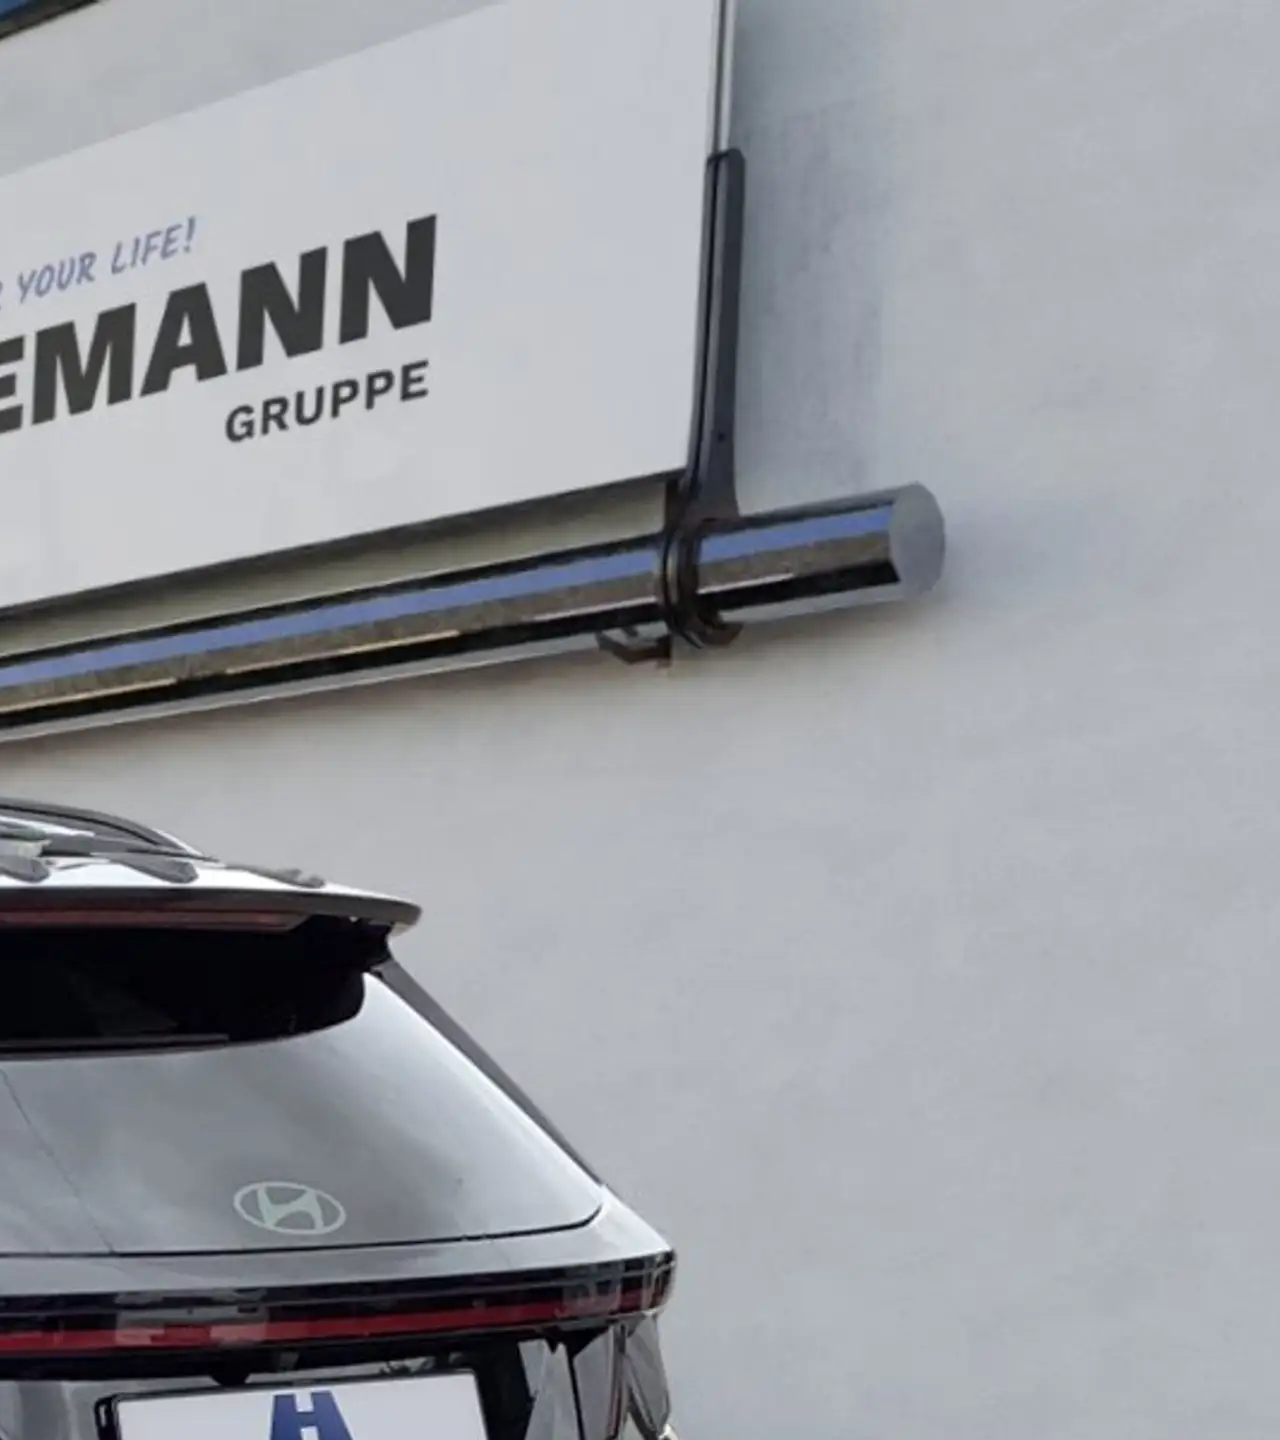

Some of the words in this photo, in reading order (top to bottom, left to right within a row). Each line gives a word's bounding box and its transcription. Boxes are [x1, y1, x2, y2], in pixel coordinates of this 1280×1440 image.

[17, 251, 97, 305] YOUR
[109, 215, 197, 276] LIFE!
[224, 358, 430, 444] GRUPPE
